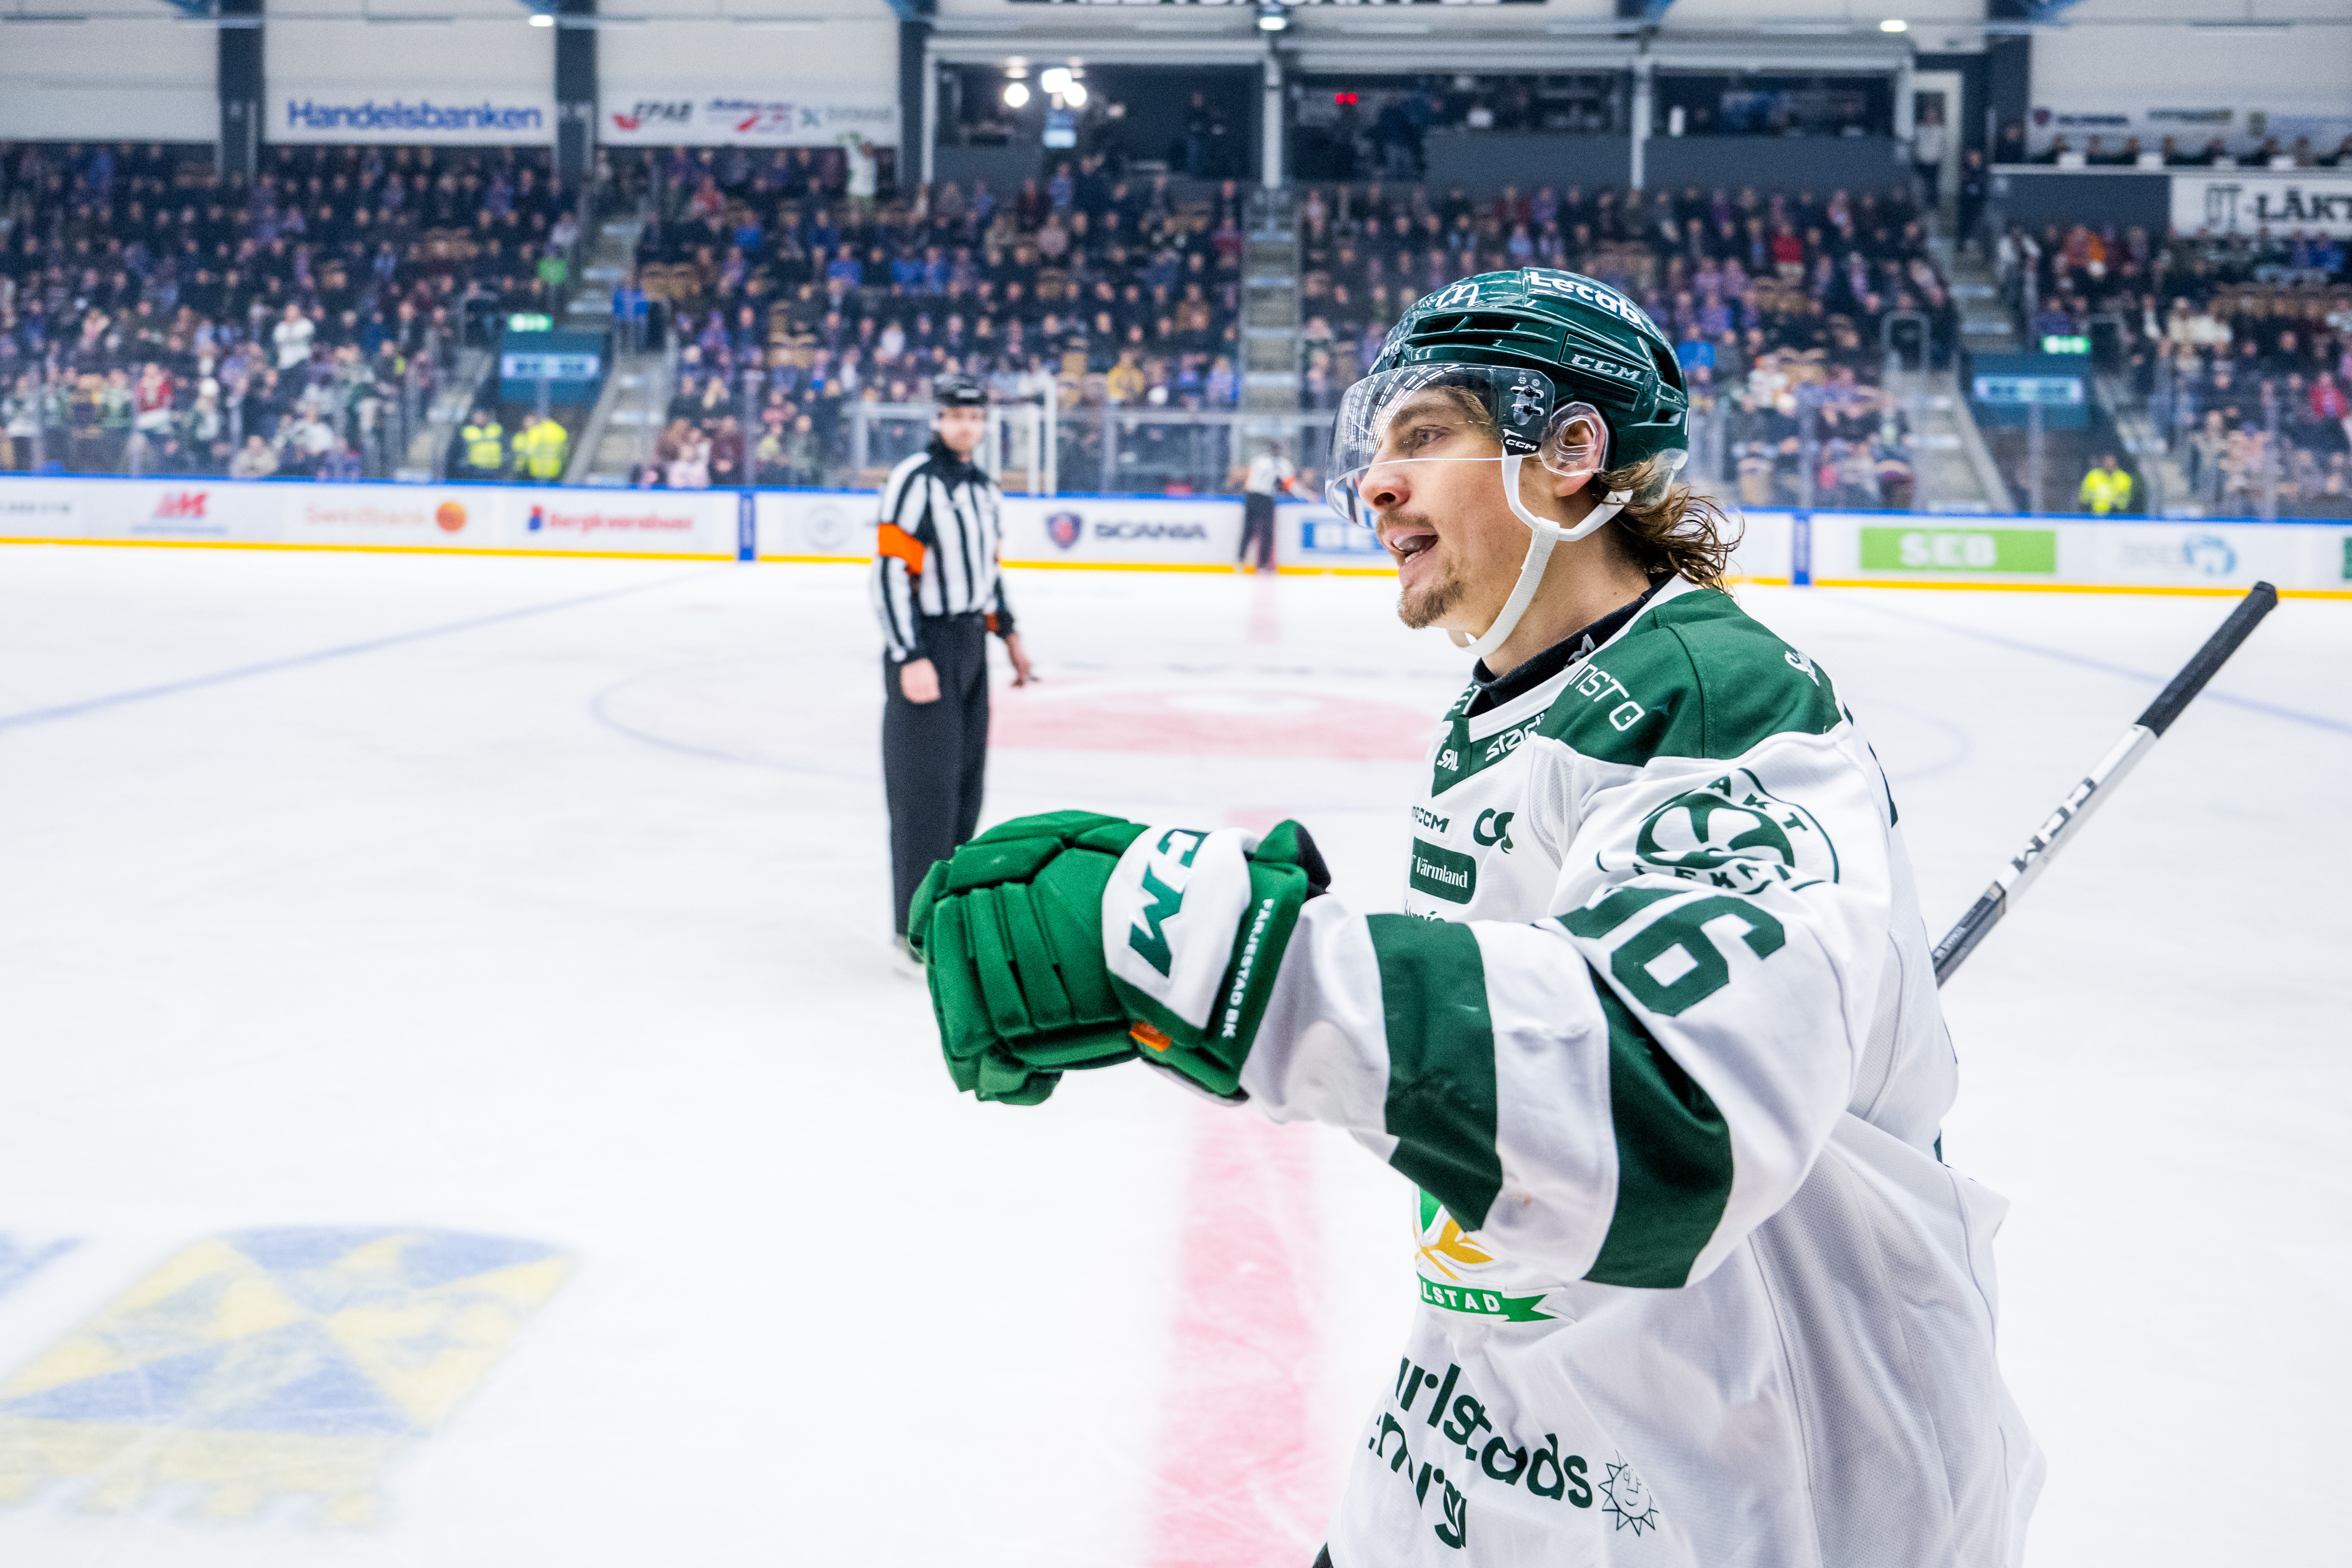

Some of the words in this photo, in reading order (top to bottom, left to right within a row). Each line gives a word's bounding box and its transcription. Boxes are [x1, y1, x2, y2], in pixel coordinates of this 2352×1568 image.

[287, 99, 542, 130] Handelsbanken
[1530, 271, 1643, 325] Lecab
[1571, 354, 1641, 381] CCM
[1505, 438, 1538, 451] CCM
[1094, 522, 1207, 541] SCANIA
[1899, 531, 1997, 567] SEB
[1416, 855, 1468, 889] Värmland
[1419, 1281, 1501, 1312] LSTAD
